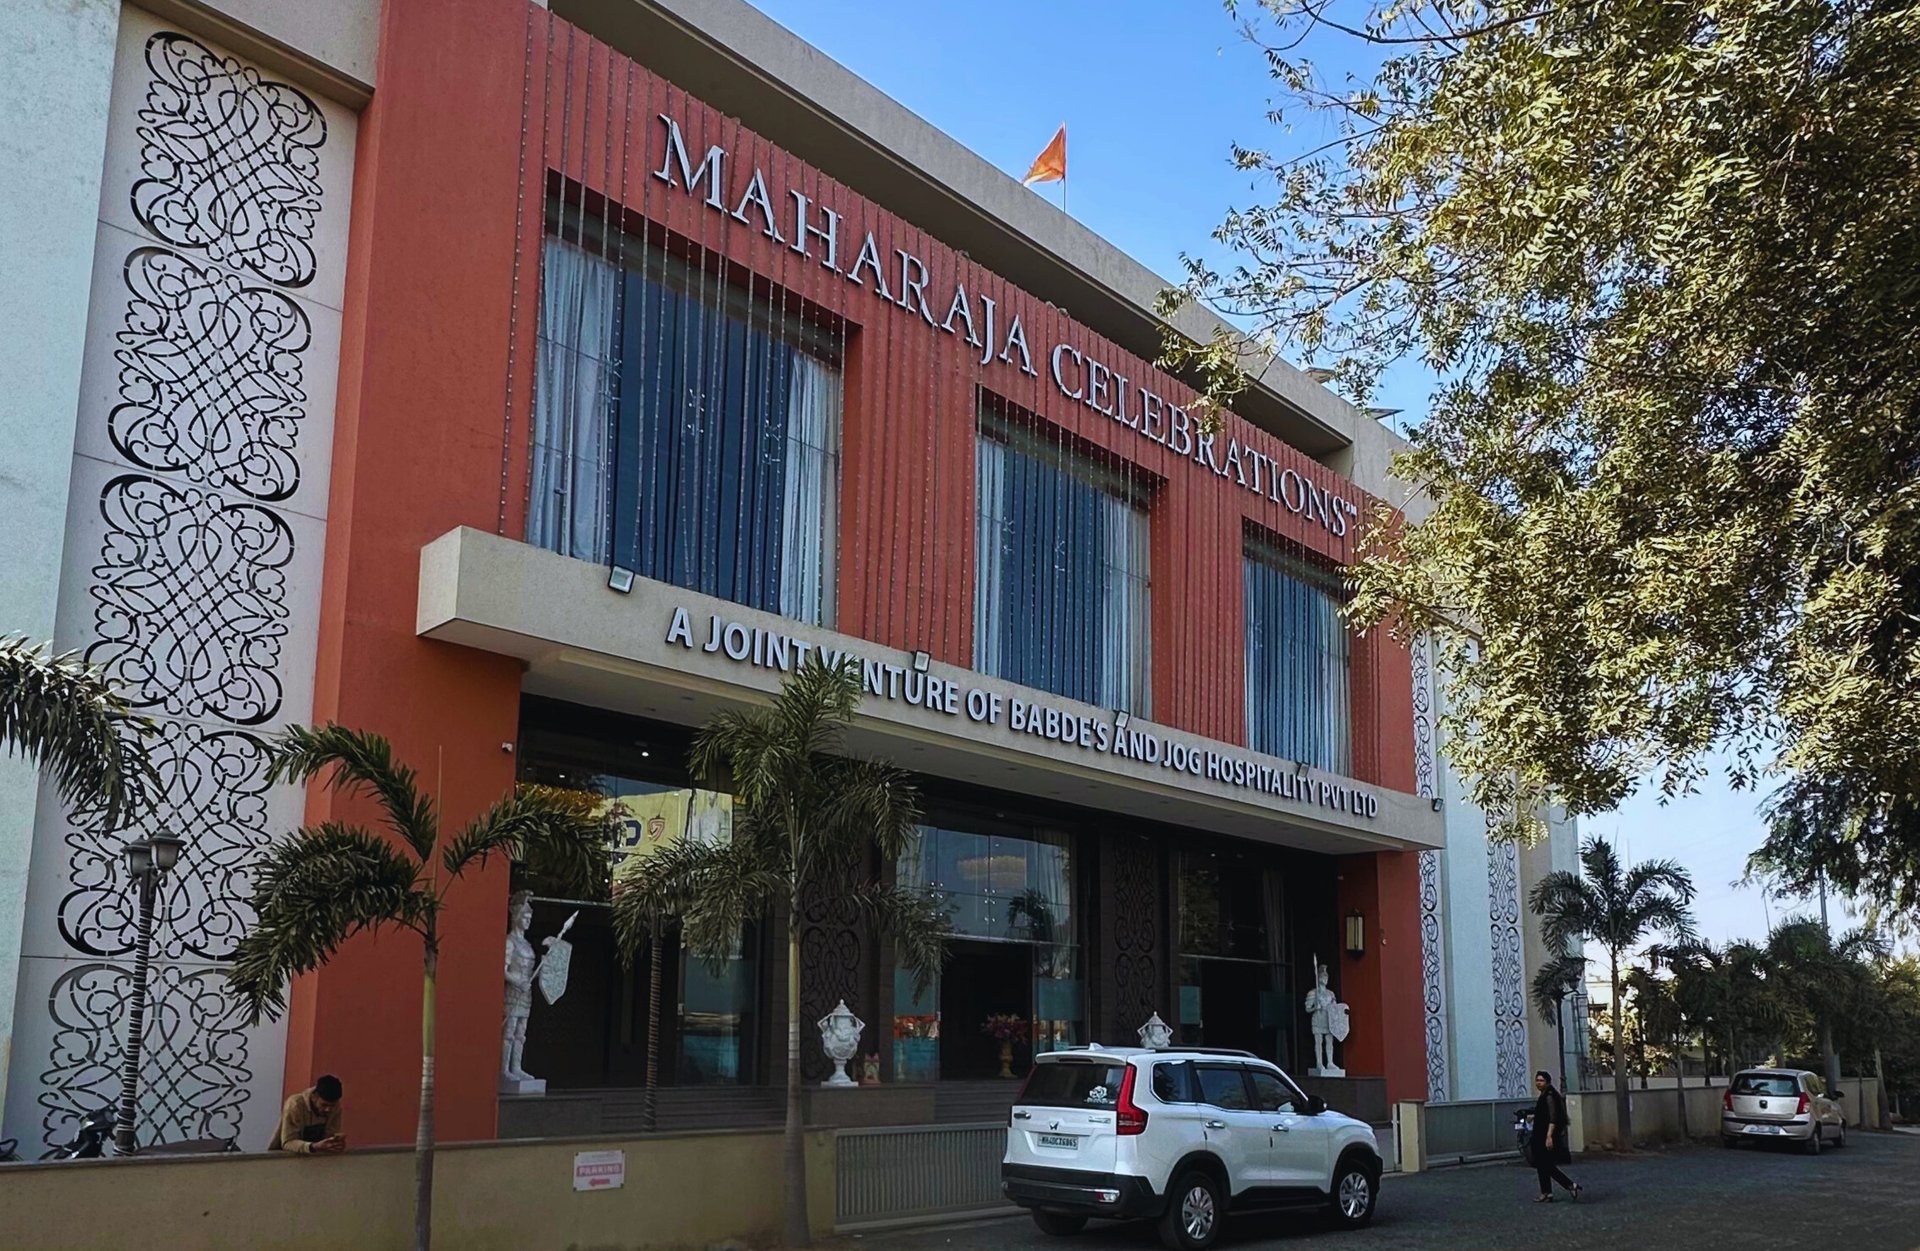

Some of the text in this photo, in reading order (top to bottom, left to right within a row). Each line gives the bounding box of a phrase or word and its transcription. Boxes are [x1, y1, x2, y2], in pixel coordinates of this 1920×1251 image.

[653, 113, 1039, 377] MAHARAJA
[666, 606, 694, 648] A
[703, 615, 811, 675] JOINT
[966, 687, 1002, 724] OF
[1009, 697, 1109, 753] BABDE'S
[1113, 724, 1160, 764] AND
[1161, 739, 1201, 775] JOG
[1206, 751, 1316, 804] HOSPITALITY
[1319, 782, 1352, 811] PVT
[1352, 789, 1379, 819] LTD
[578, 1165, 620, 1176] PARKING
